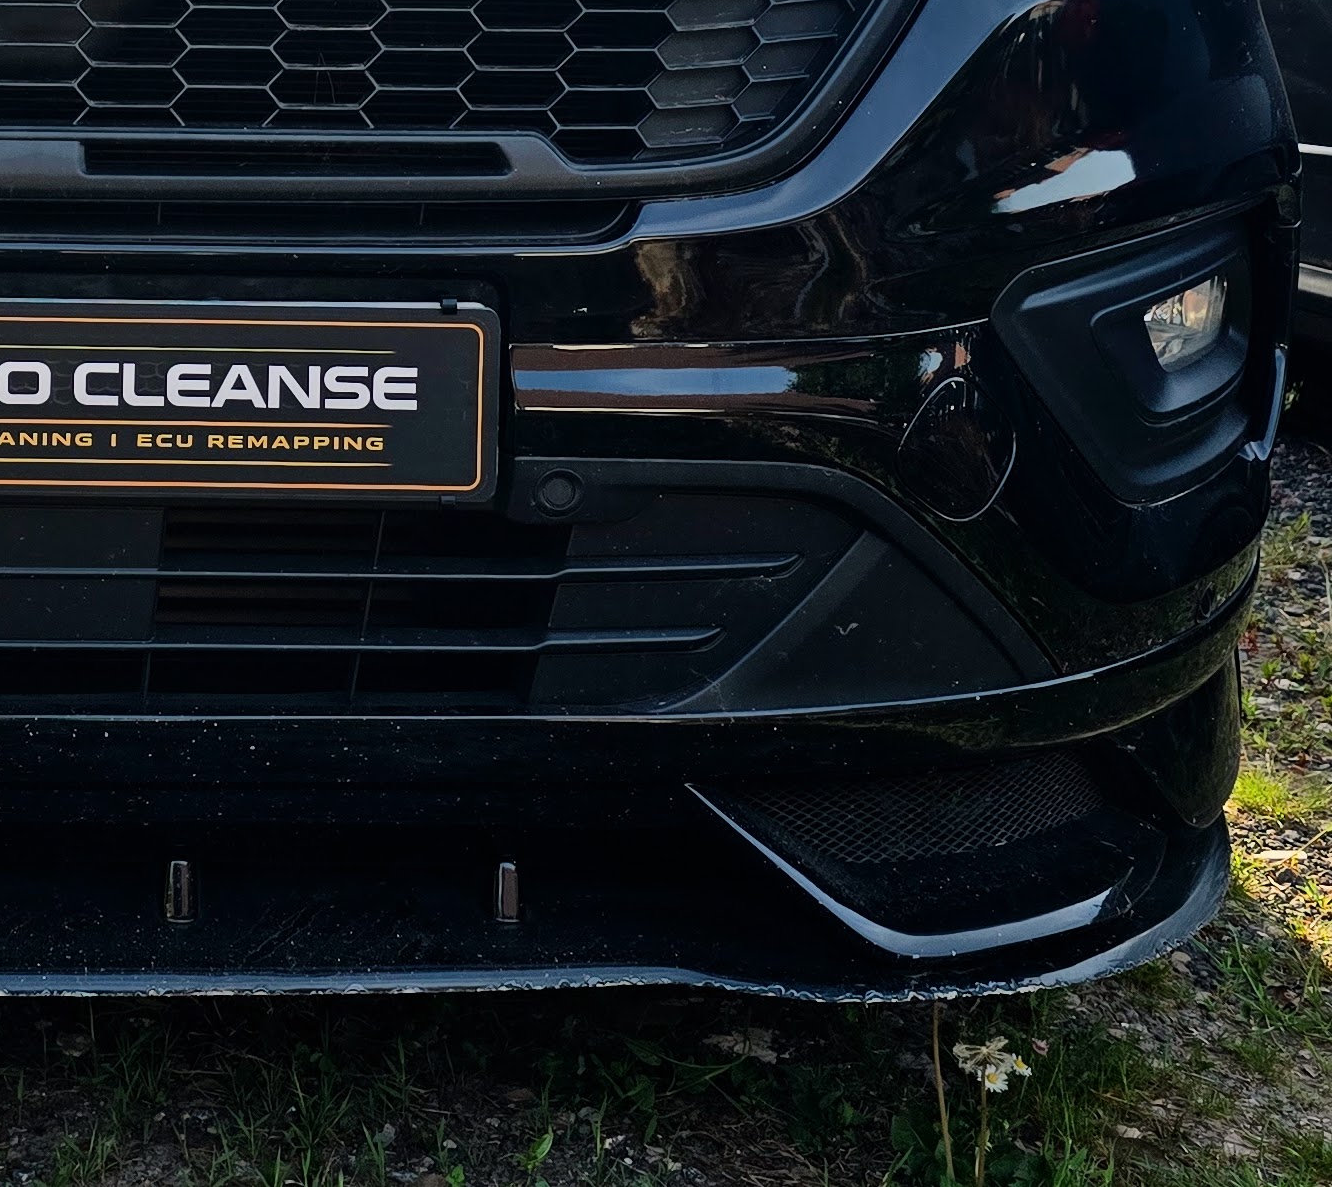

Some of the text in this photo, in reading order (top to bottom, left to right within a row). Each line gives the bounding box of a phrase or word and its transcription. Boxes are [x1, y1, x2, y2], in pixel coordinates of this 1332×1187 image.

[73, 362, 419, 411] CLEANSE
[137, 433, 195, 449] ECU
[208, 434, 385, 452] REMAPPING
